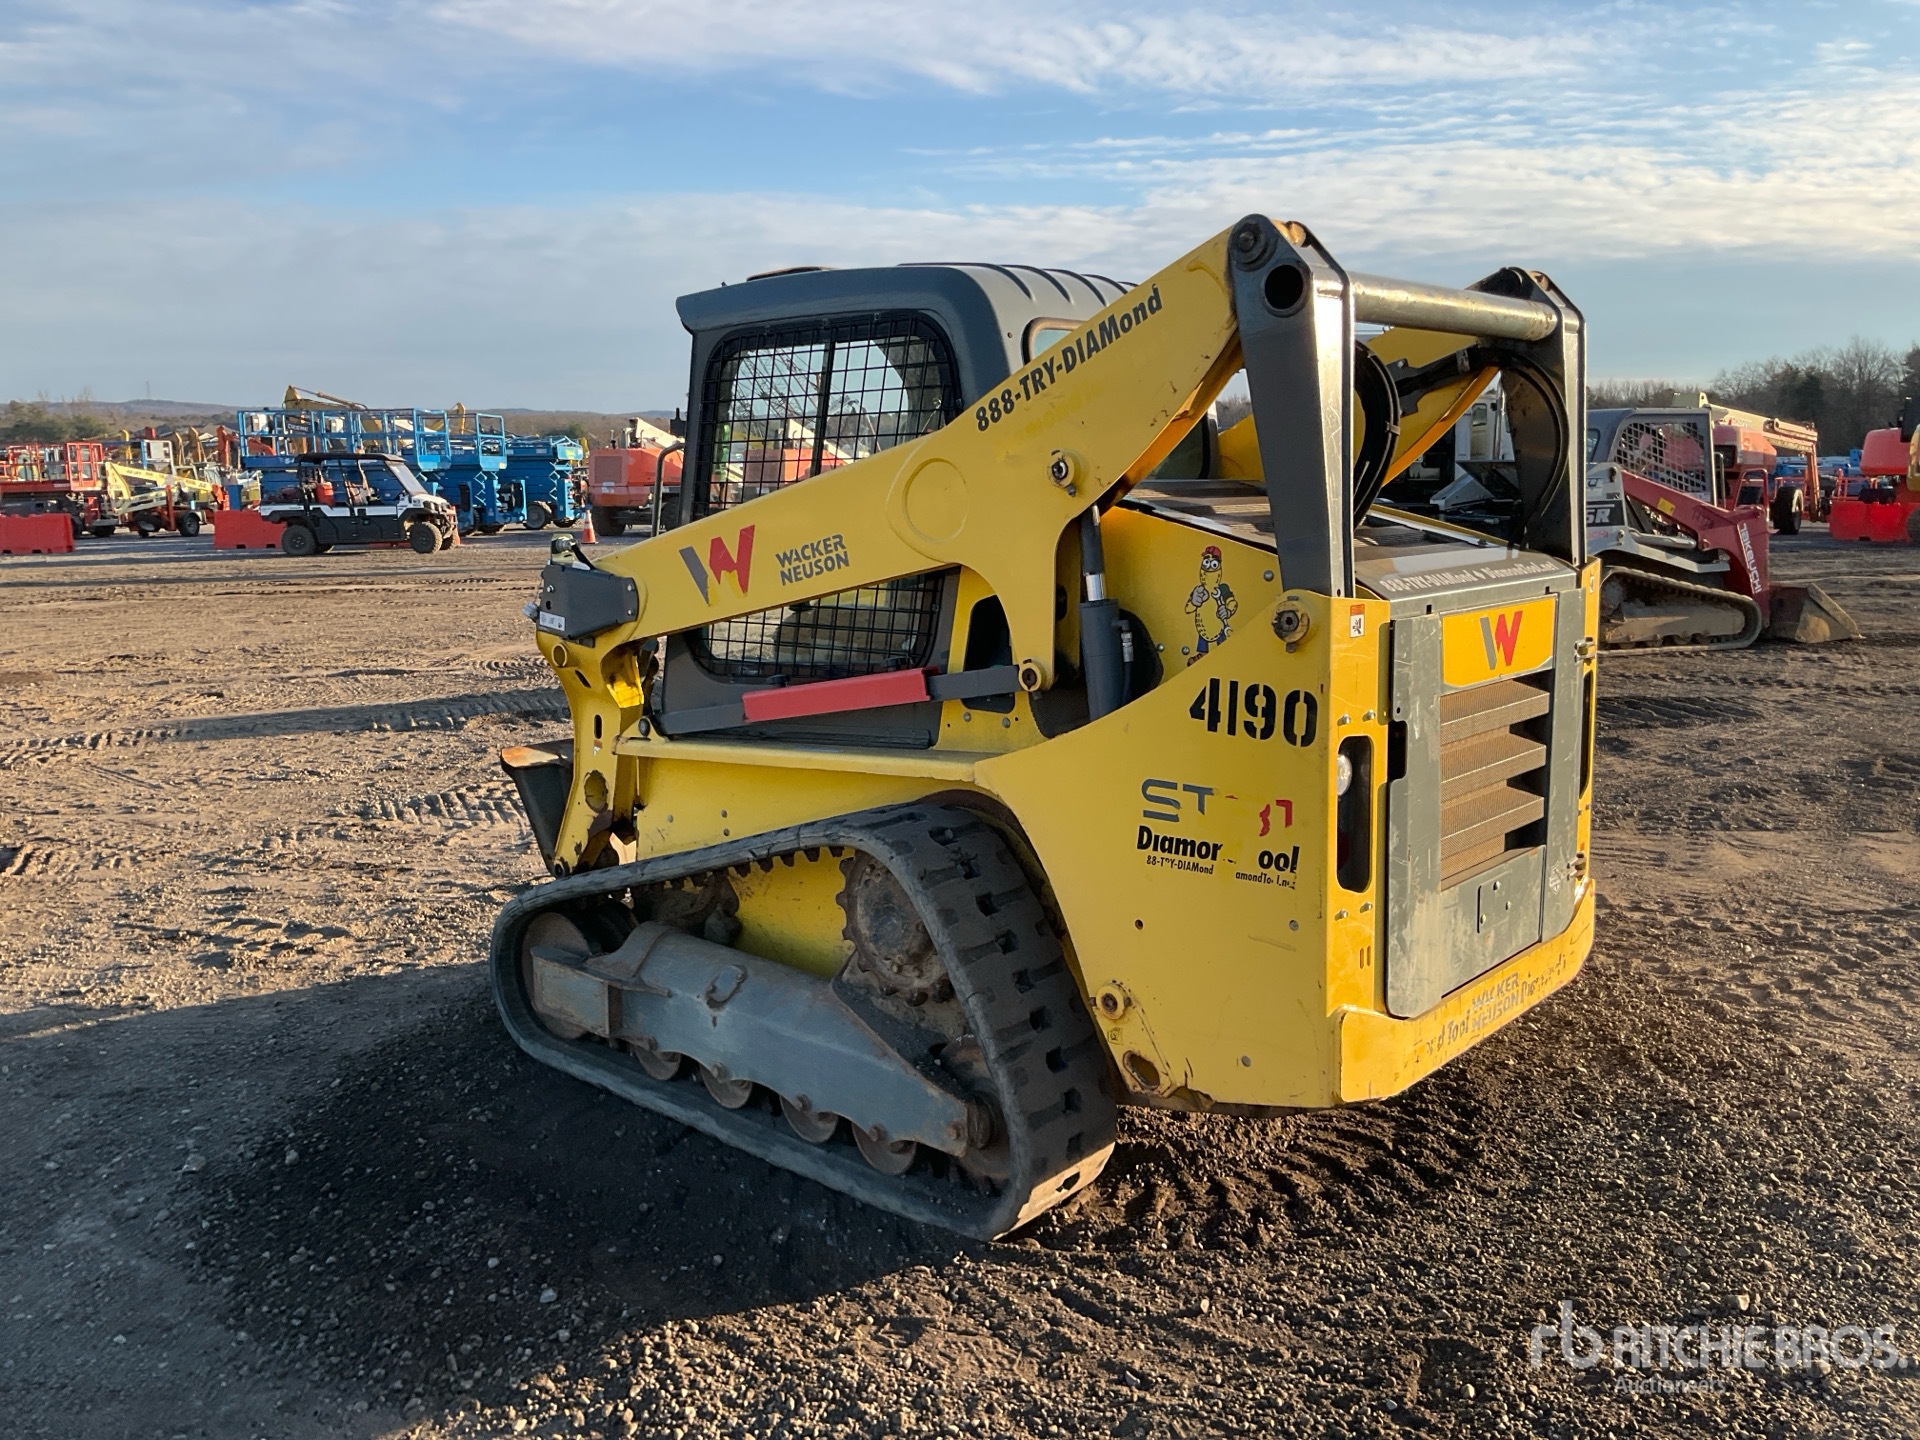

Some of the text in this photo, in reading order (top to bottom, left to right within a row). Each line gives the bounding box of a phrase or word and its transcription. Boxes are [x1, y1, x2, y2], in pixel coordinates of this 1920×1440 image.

[975, 284, 1163, 432] 888-TRY-DIAMond
[774, 533, 847, 568] WACKER
[779, 550, 850, 586] NEUSON
[1189, 677, 1319, 748] 4190
